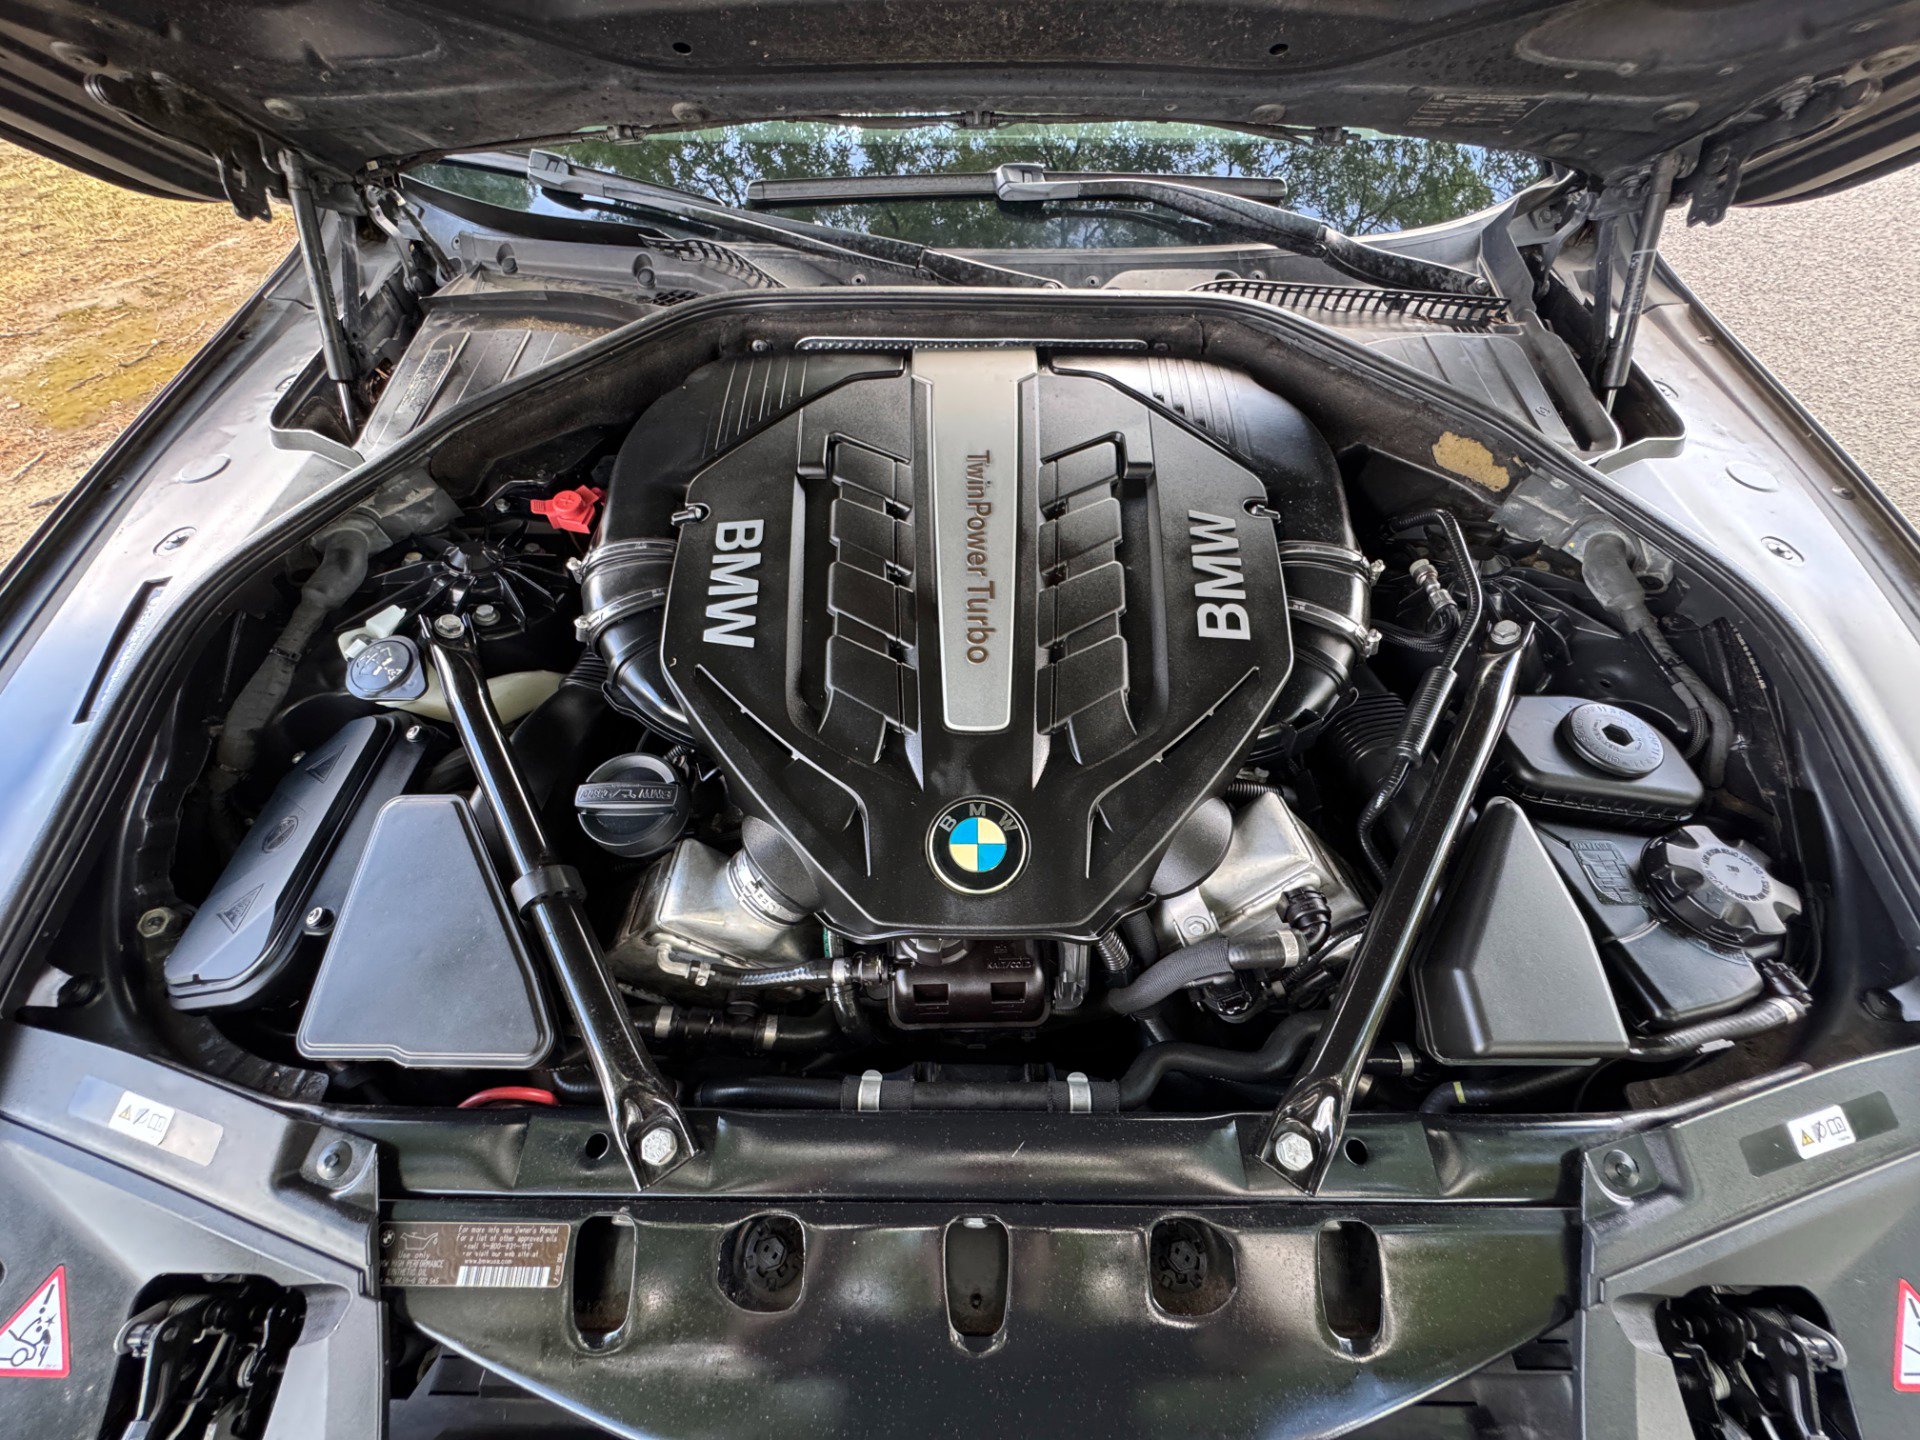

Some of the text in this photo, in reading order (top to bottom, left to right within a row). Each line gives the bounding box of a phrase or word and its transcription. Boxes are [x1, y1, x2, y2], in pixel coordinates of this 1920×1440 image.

[702, 519, 765, 649] BMW
[1188, 509, 1251, 641] BMW
[966, 580, 997, 664] Turbo
[939, 803, 1019, 833] BMW
[476, 1233, 487, 1242] list
[490, 1234, 497, 1242] of
[499, 1234, 515, 1242] other
[517, 1234, 544, 1244] approved
[546, 1235, 558, 1243] oils
[487, 1226, 499, 1234] info
[514, 1225, 537, 1234] Owner's
[539, 1225, 559, 1234] Manual
[414, 1251, 432, 1261] only
